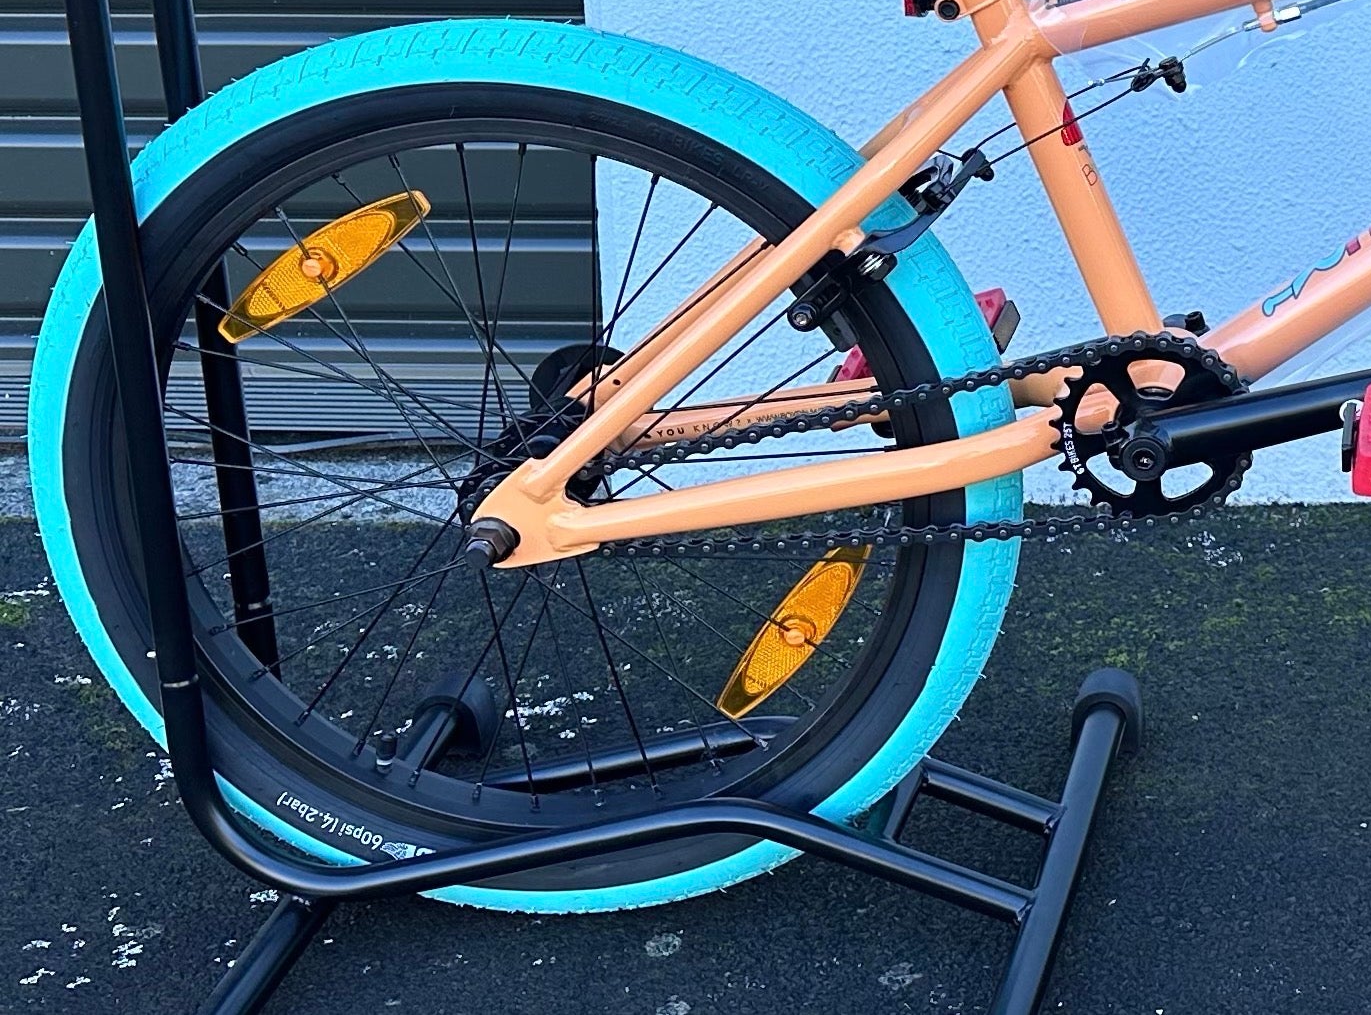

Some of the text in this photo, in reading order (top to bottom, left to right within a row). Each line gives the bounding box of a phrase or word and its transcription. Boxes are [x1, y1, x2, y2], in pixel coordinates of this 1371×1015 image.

[656, 427, 685, 438] YOU
[1064, 440, 1080, 464] BIKES
[275, 791, 384, 851] 60psi (4.2bar)
